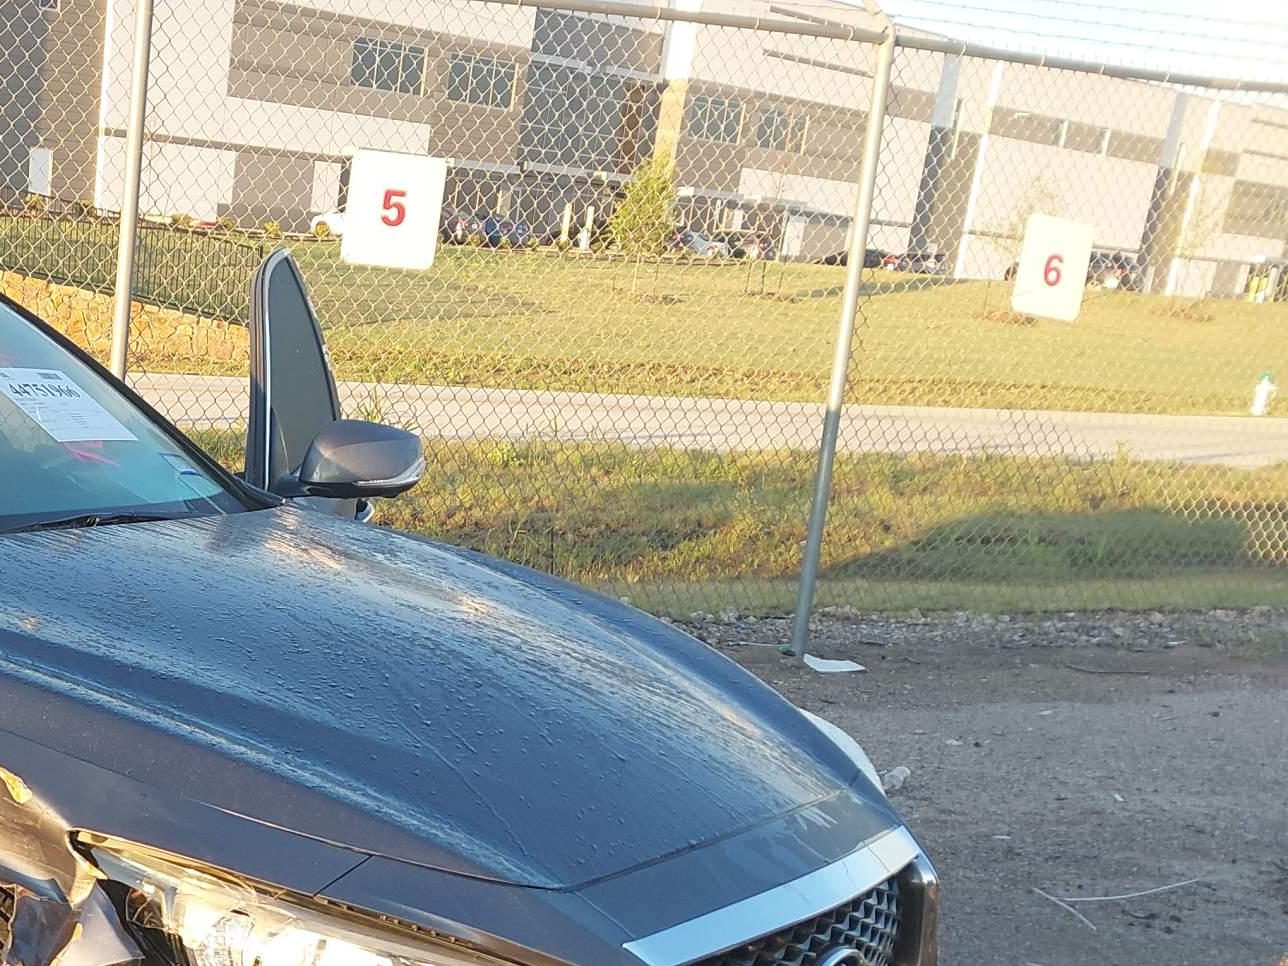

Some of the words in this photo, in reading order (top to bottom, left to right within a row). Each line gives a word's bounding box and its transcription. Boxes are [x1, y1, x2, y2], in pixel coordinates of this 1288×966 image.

[380, 189, 407, 228] 5
[1044, 254, 1064, 287] 6
[8, 383, 81, 399] 44751966
